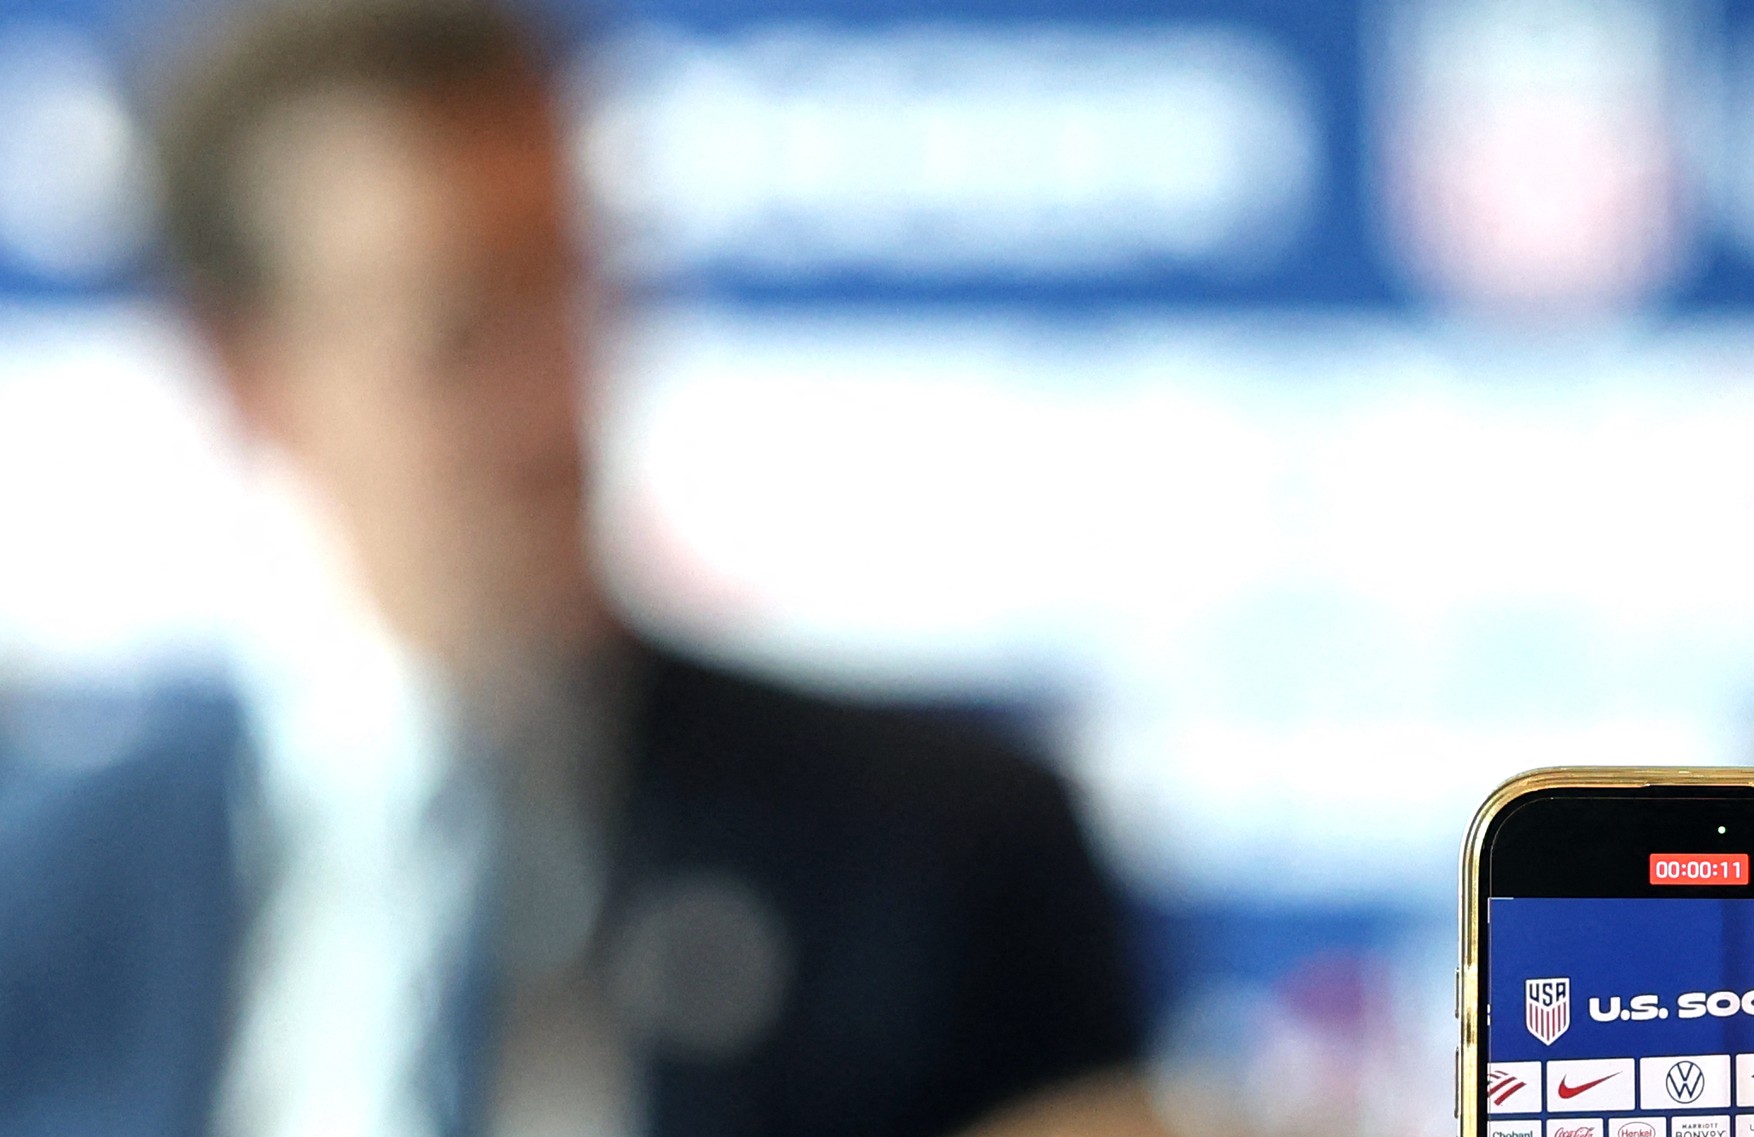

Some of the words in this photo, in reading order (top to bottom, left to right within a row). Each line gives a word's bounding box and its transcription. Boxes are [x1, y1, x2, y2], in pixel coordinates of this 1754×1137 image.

[1655, 861, 1742, 879] 00:00:11
[1529, 981, 1567, 1007] USA
[1588, 994, 1669, 1022] U.S.
[1682, 1122, 1719, 1130] MARRIOTT
